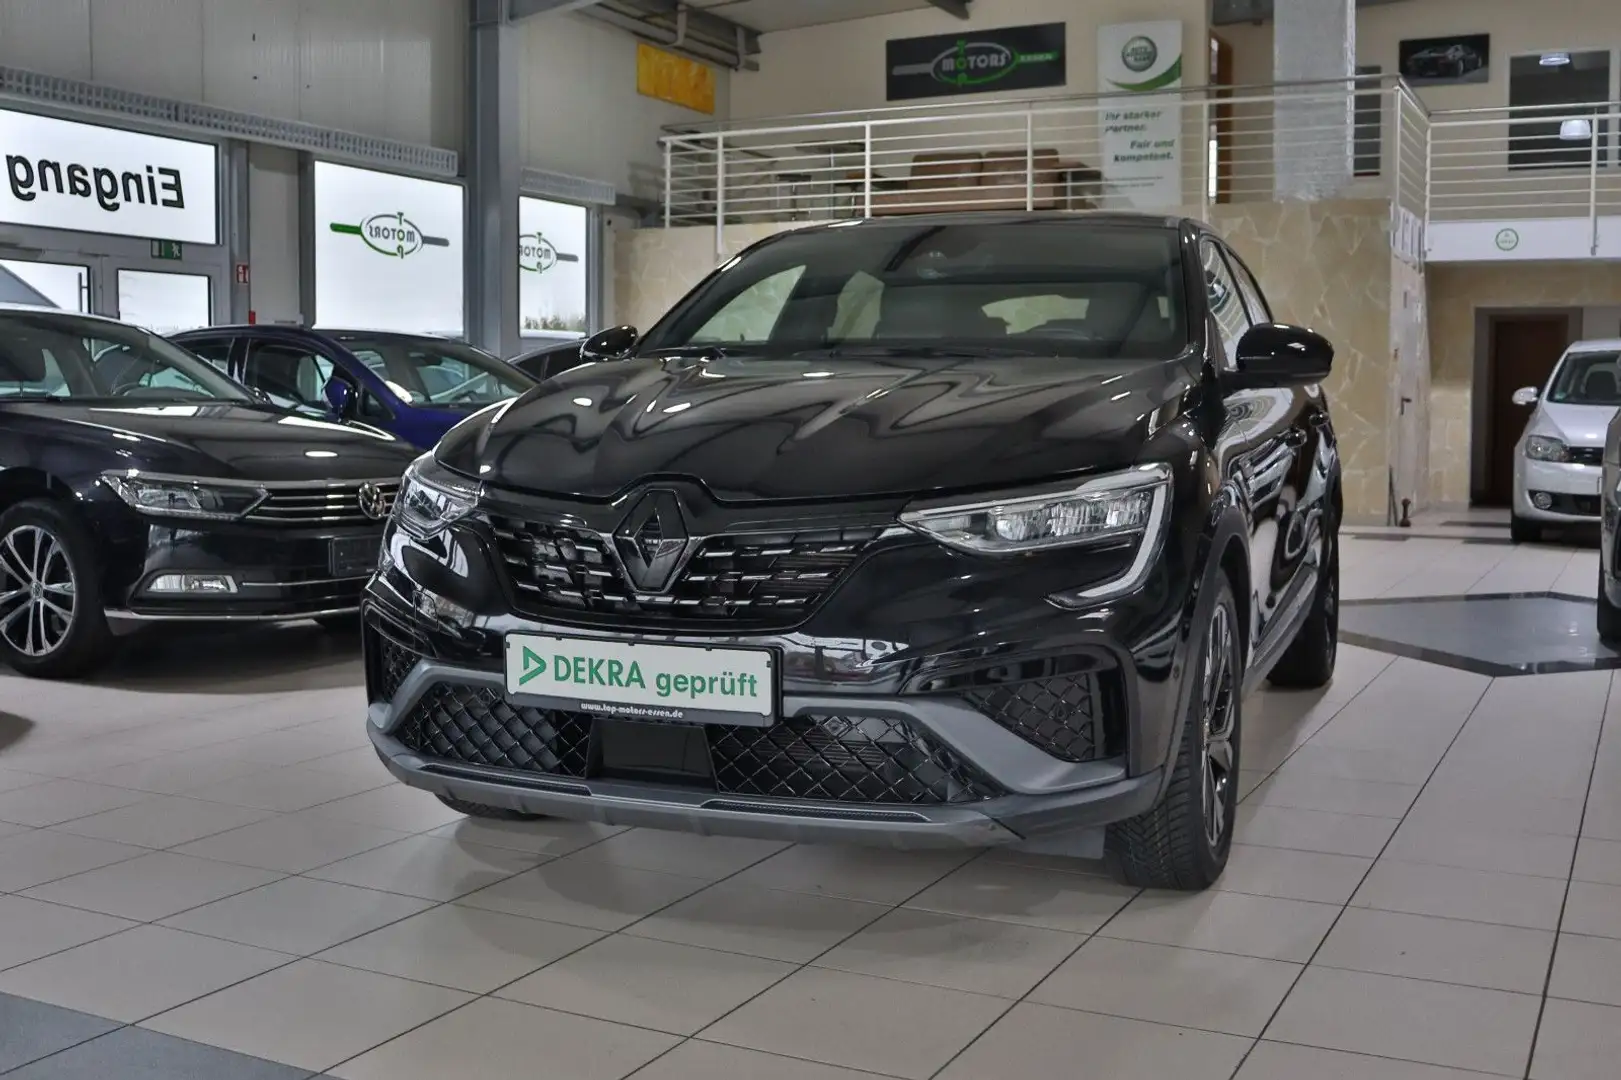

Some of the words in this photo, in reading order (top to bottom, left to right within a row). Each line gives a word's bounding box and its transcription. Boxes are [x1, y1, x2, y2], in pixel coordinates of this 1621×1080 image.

[942, 54, 1006, 71] MOTORS
[553, 654, 647, 689] DEKRA
[655, 671, 758, 700] geprüft
[581, 703, 683, 718] www.top-motors-essen.de
